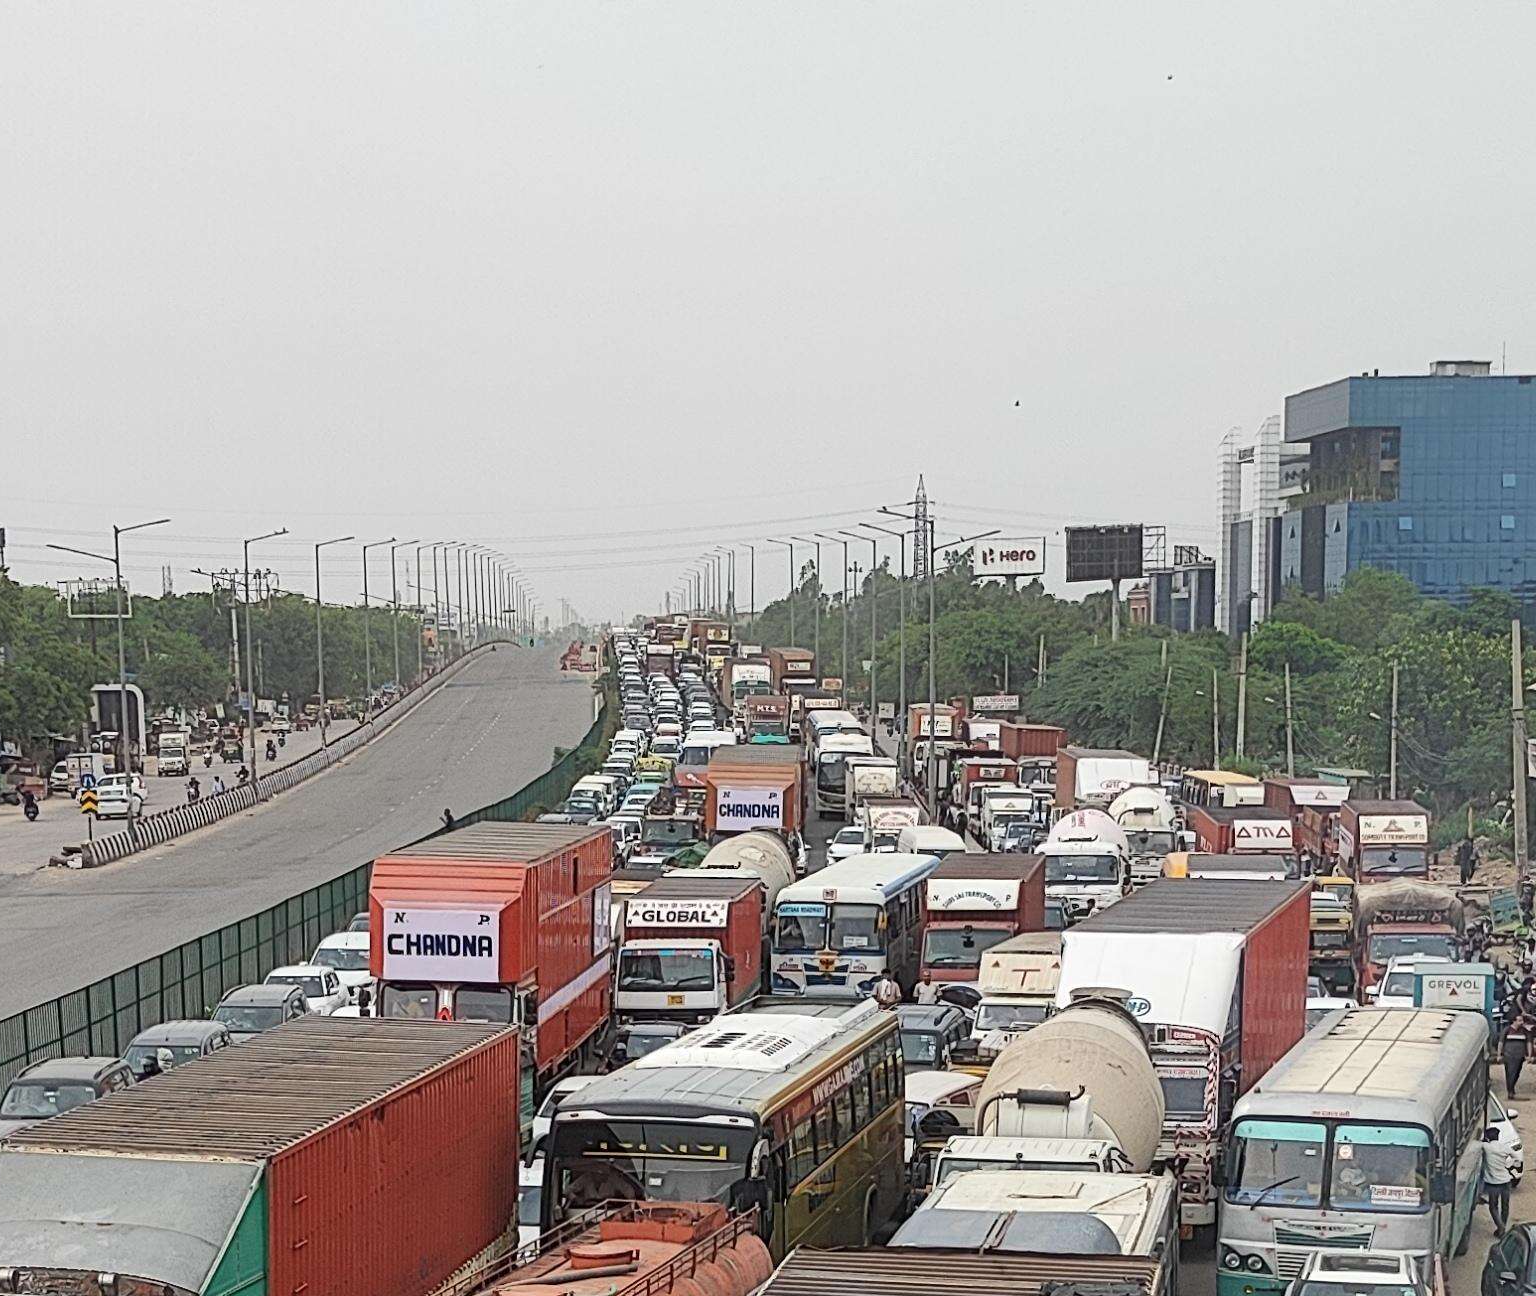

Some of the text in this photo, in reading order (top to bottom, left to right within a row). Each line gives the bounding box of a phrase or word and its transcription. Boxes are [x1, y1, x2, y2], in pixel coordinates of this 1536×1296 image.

[1000, 549, 1036, 562] Hero
[719, 803, 780, 819] CHANDNA
[641, 910, 712, 923] GLOBAL
[387, 933, 493, 957] CHANDNA
[1428, 979, 1480, 990] GREVOL
